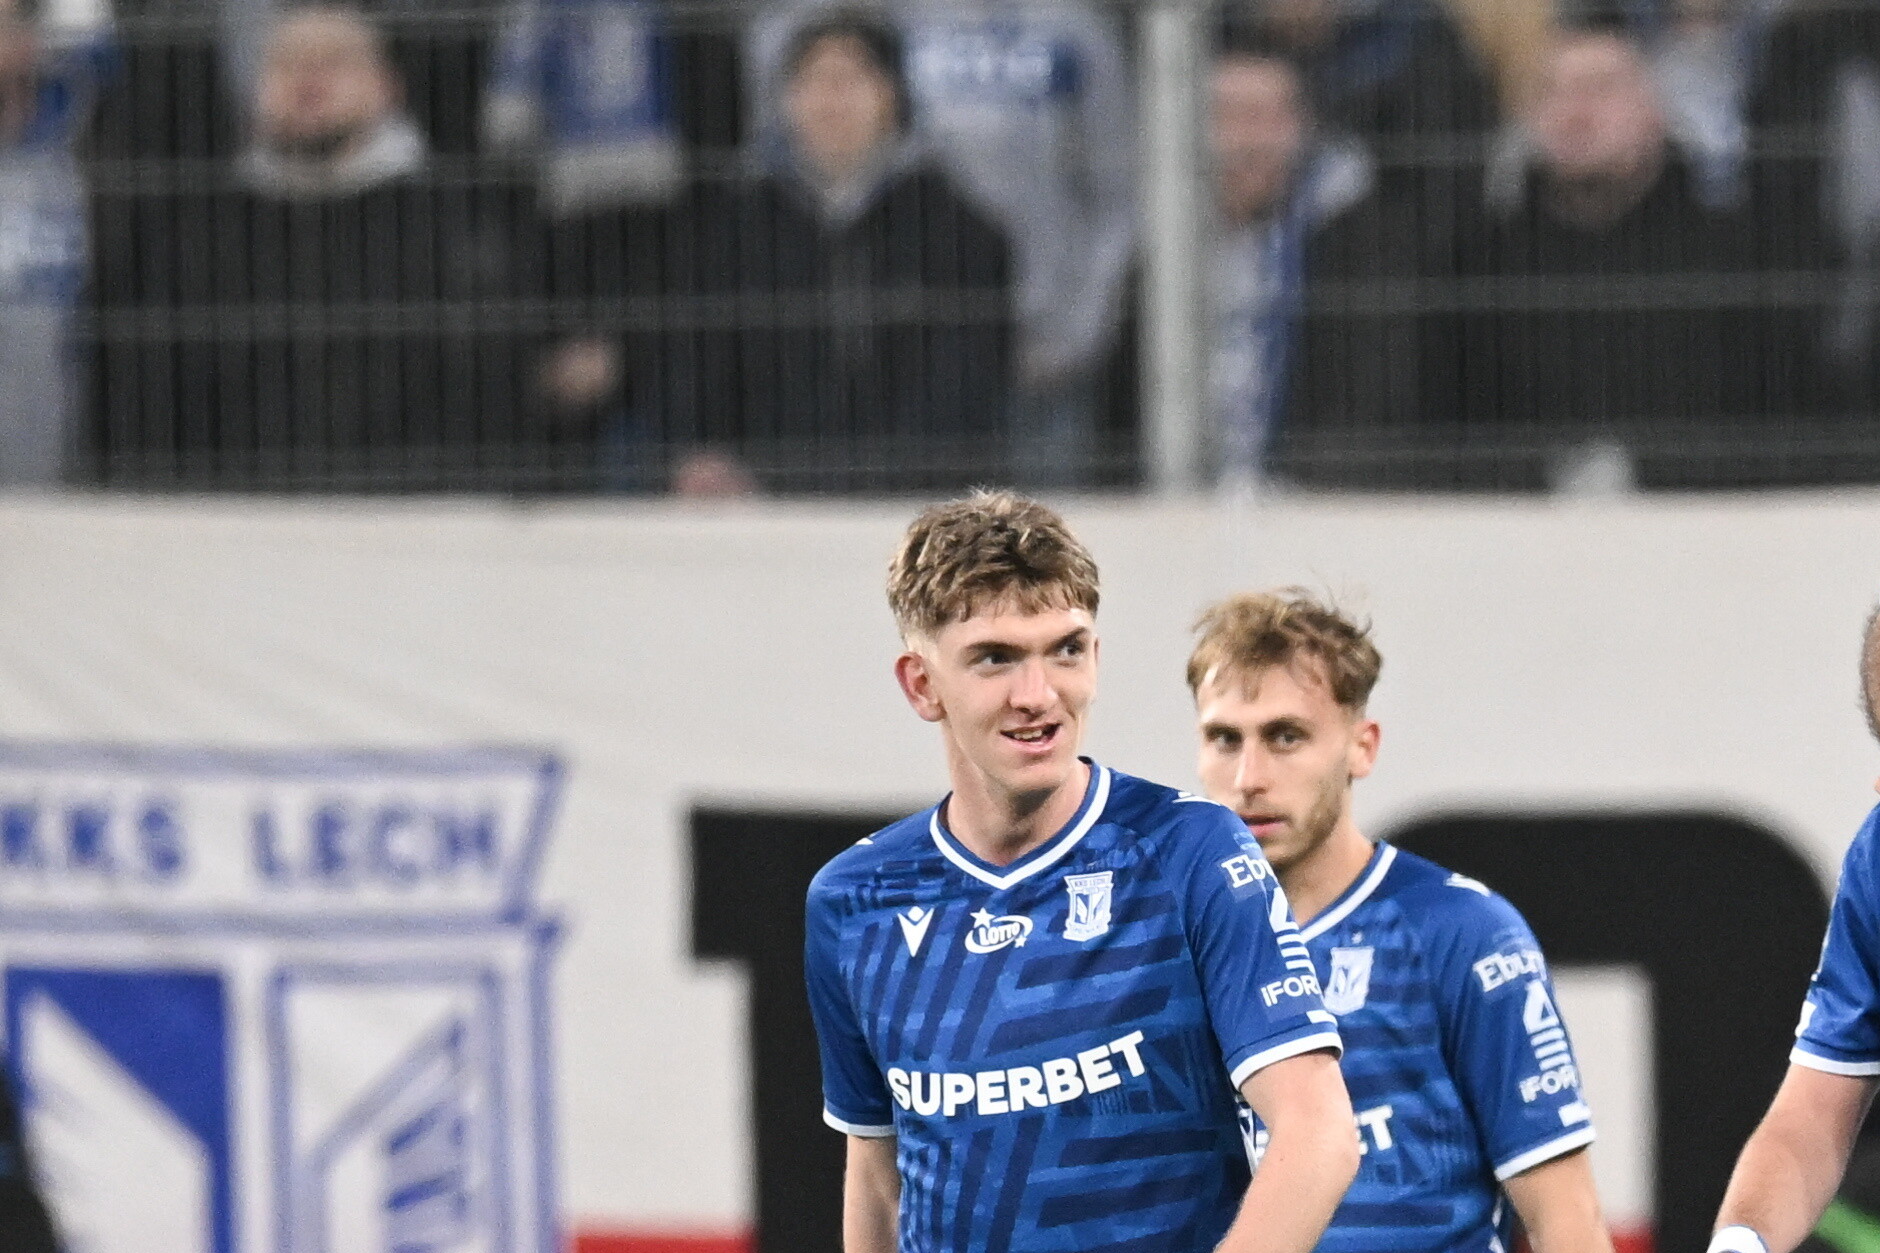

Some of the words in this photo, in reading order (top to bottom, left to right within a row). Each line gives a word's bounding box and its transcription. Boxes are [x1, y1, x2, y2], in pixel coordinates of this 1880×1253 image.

[246, 803, 500, 885] LECH
[978, 922, 1020, 946] LOTTO
[887, 1029, 1145, 1117] SUPERBET
